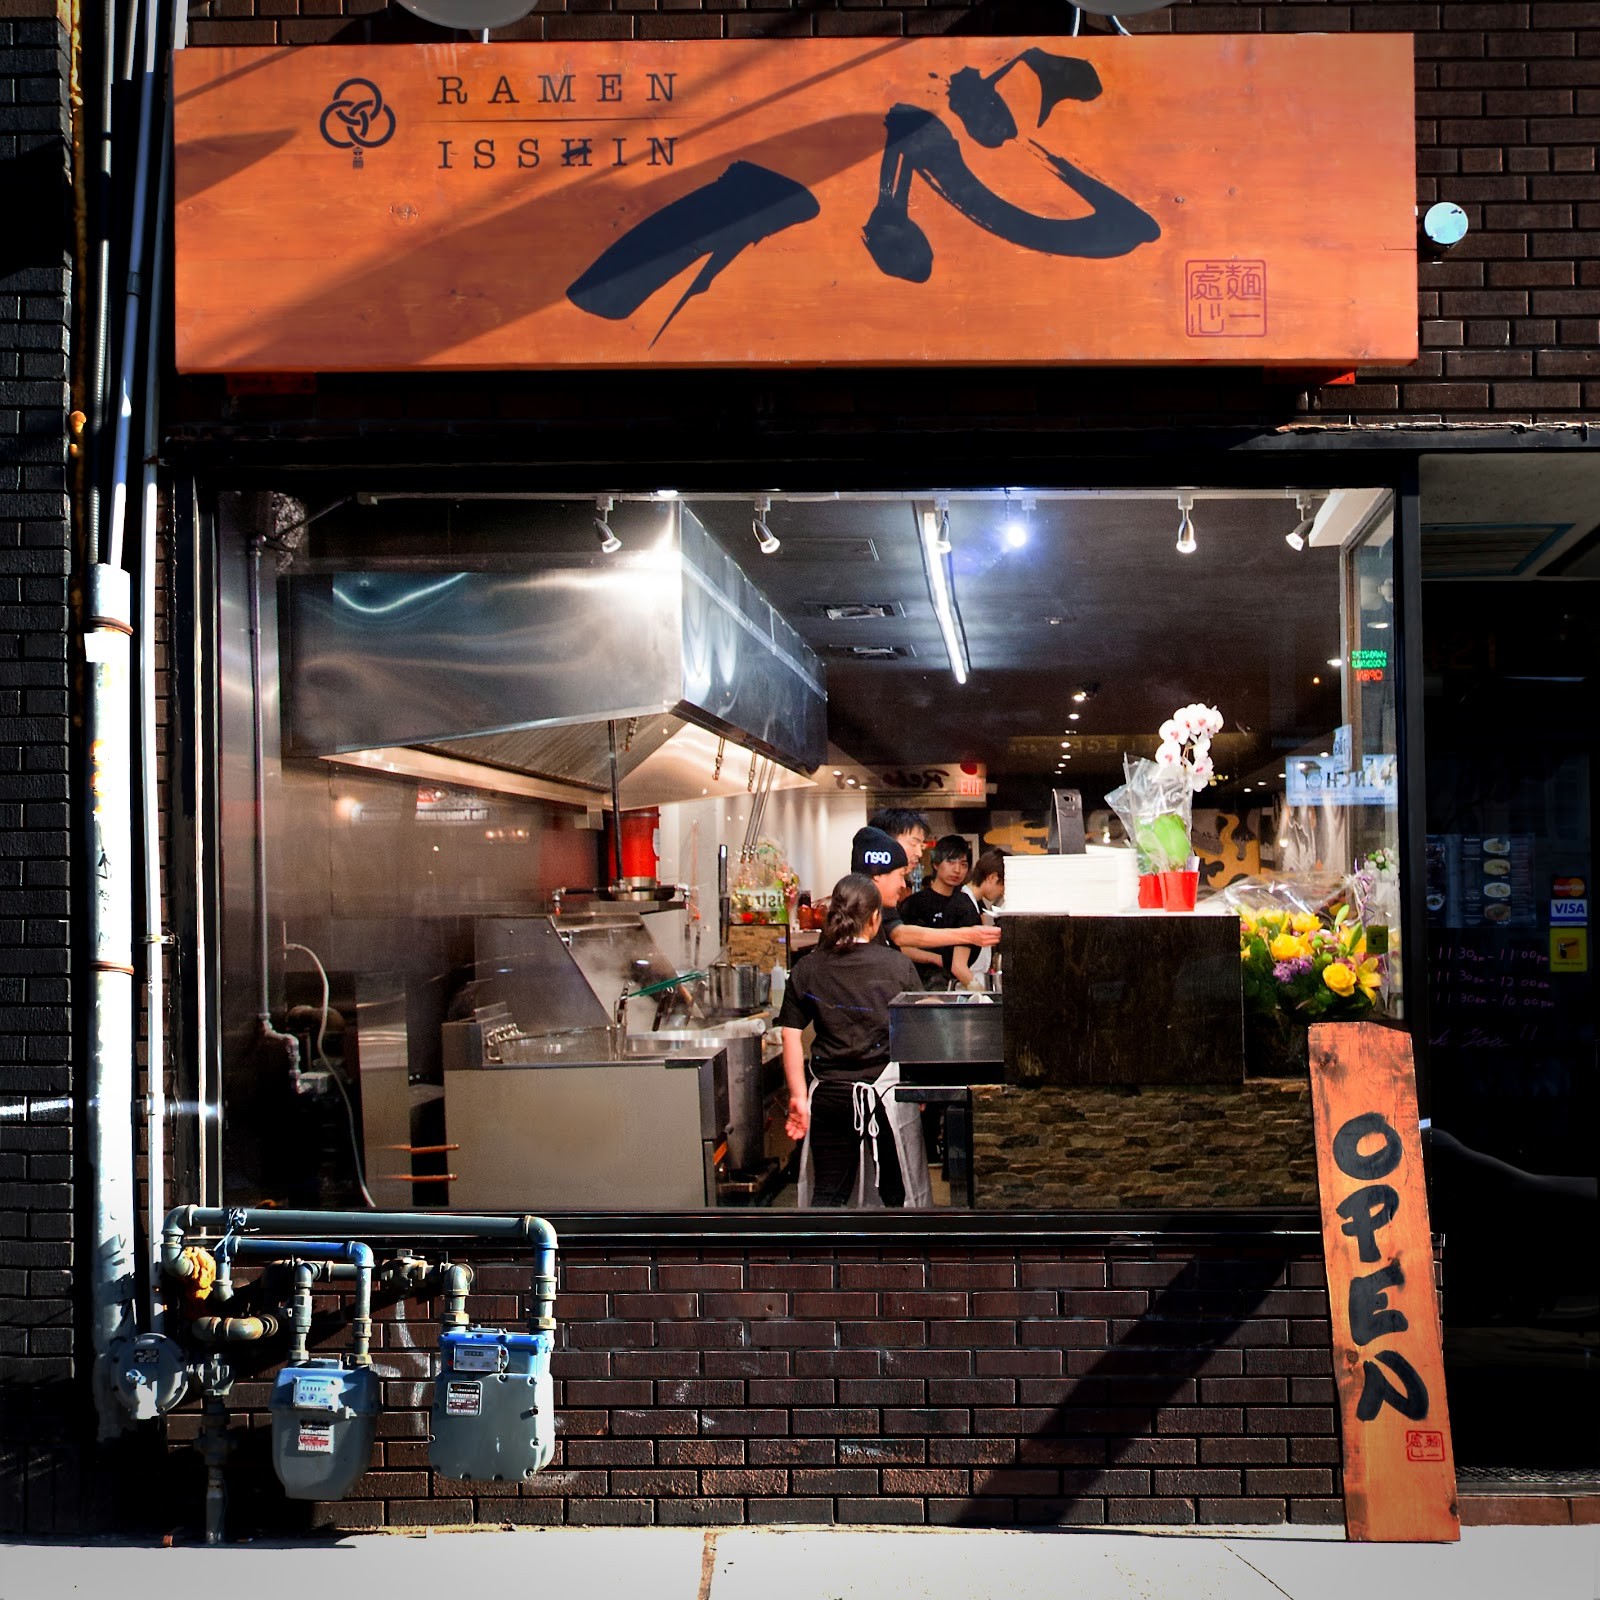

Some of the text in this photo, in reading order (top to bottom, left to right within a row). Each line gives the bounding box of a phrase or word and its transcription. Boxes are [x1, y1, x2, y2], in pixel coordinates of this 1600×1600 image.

[437, 72, 678, 105] RAMEN
[437, 136, 679, 170] ISSHIN
[961, 778, 982, 796] EXIT
[1554, 902, 1585, 914] VISA
[1332, 1111, 1430, 1423] OPEN
